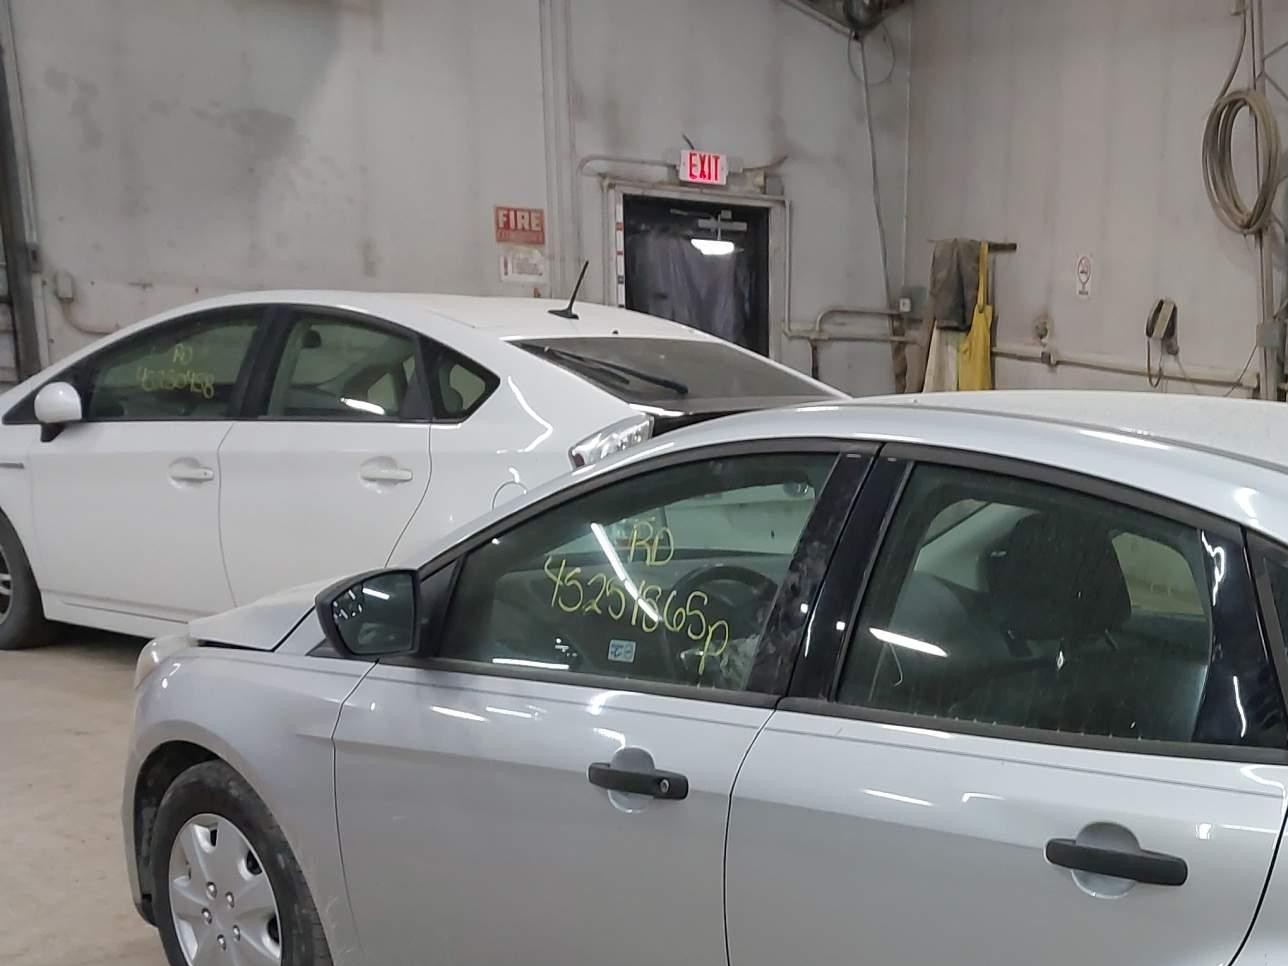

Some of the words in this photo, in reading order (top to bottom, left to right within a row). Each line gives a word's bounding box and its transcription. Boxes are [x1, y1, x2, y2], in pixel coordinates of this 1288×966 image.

[689, 152, 720, 181] EXIT
[497, 209, 542, 231] FIRE
[628, 521, 674, 566] RD
